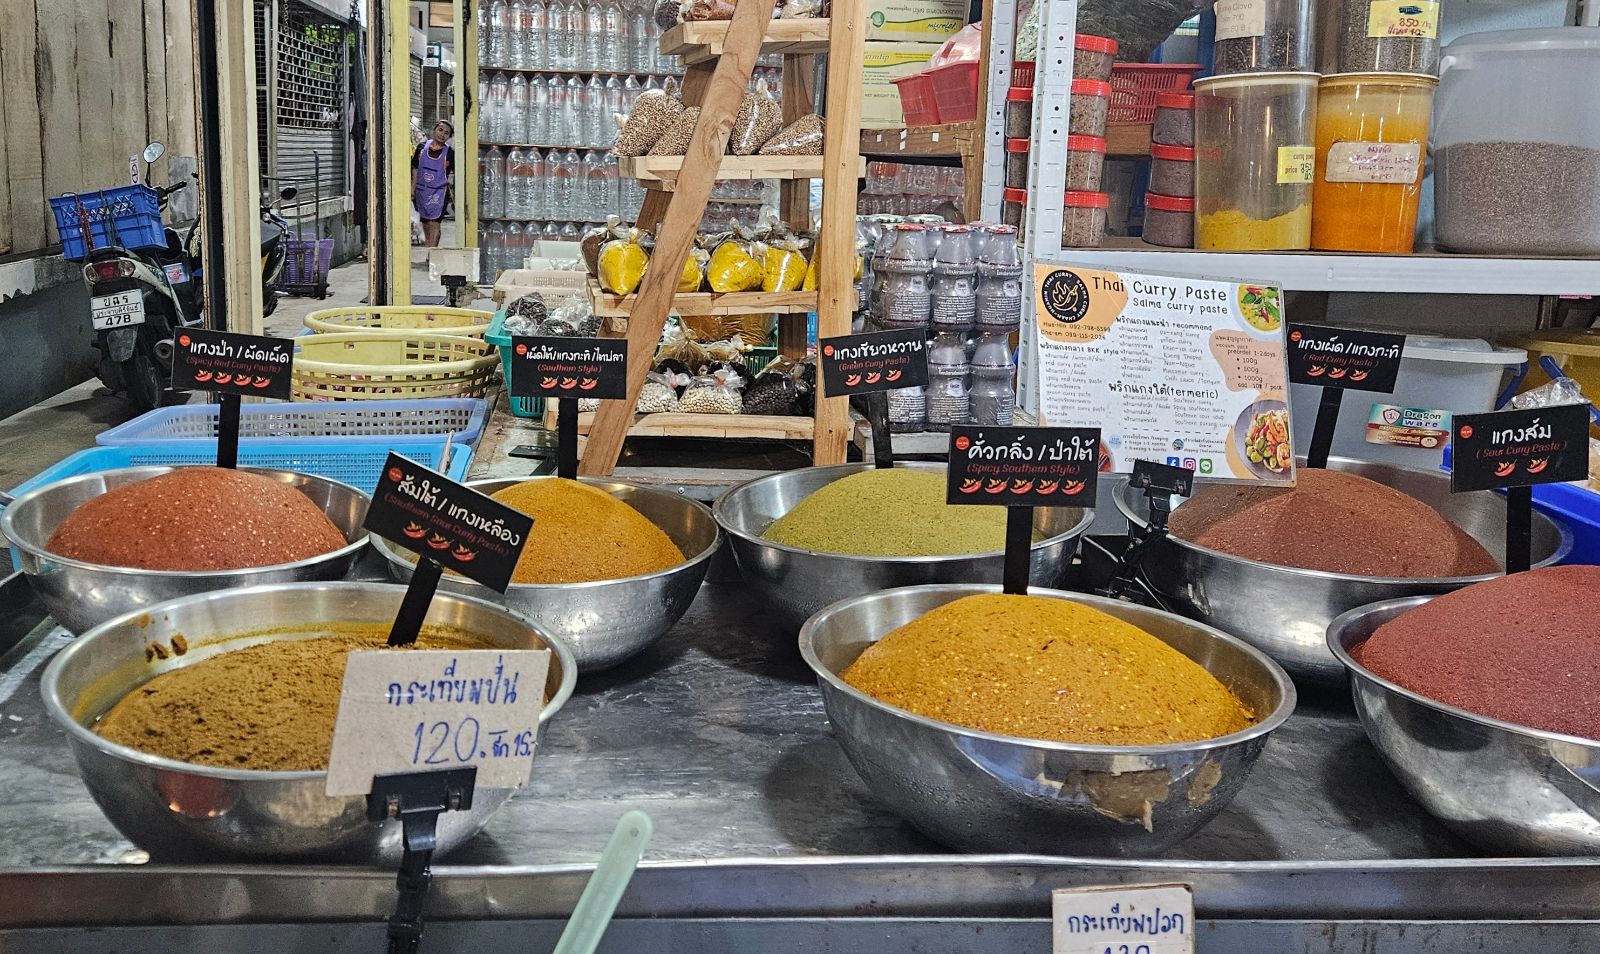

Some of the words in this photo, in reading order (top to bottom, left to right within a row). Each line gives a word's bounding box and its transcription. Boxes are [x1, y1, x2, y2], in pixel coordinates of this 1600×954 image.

[1045, 276, 1055, 288] THAI
[1092, 276, 1125, 293] Thai
[1133, 281, 1177, 301] Curry
[1186, 286, 1227, 301] Paste
[1133, 298, 1162, 309] Salma
[1167, 302, 1195, 314] curry
[1200, 305, 1228, 316] paste
[105, 314, 131, 326] 478
[1172, 322, 1213, 331] recommend
[190, 340, 233, 358] แกงป่า
[244, 345, 289, 364] ผัดเผ็ด
[214, 358, 231, 369] Red
[838, 360, 863, 372] (Green
[885, 356, 910, 366] Paste)
[1404, 409, 1441, 420] Dragon
[1404, 420, 1438, 428] ware
[1492, 418, 1552, 444] แกงส้ม
[968, 433, 1034, 461] คั่วกลิ้ง
[1049, 436, 1095, 461] ป่าใต้
[1483, 448, 1505, 458] Sour
[1532, 442, 1560, 453] Paste
[967, 463, 1001, 476] (Spicy
[1049, 464, 1081, 477] Style)
[398, 474, 441, 507] ส้มใต้
[448, 503, 520, 547] แกงเหลือง
[387, 656, 519, 707] กระเทียมปั่น
